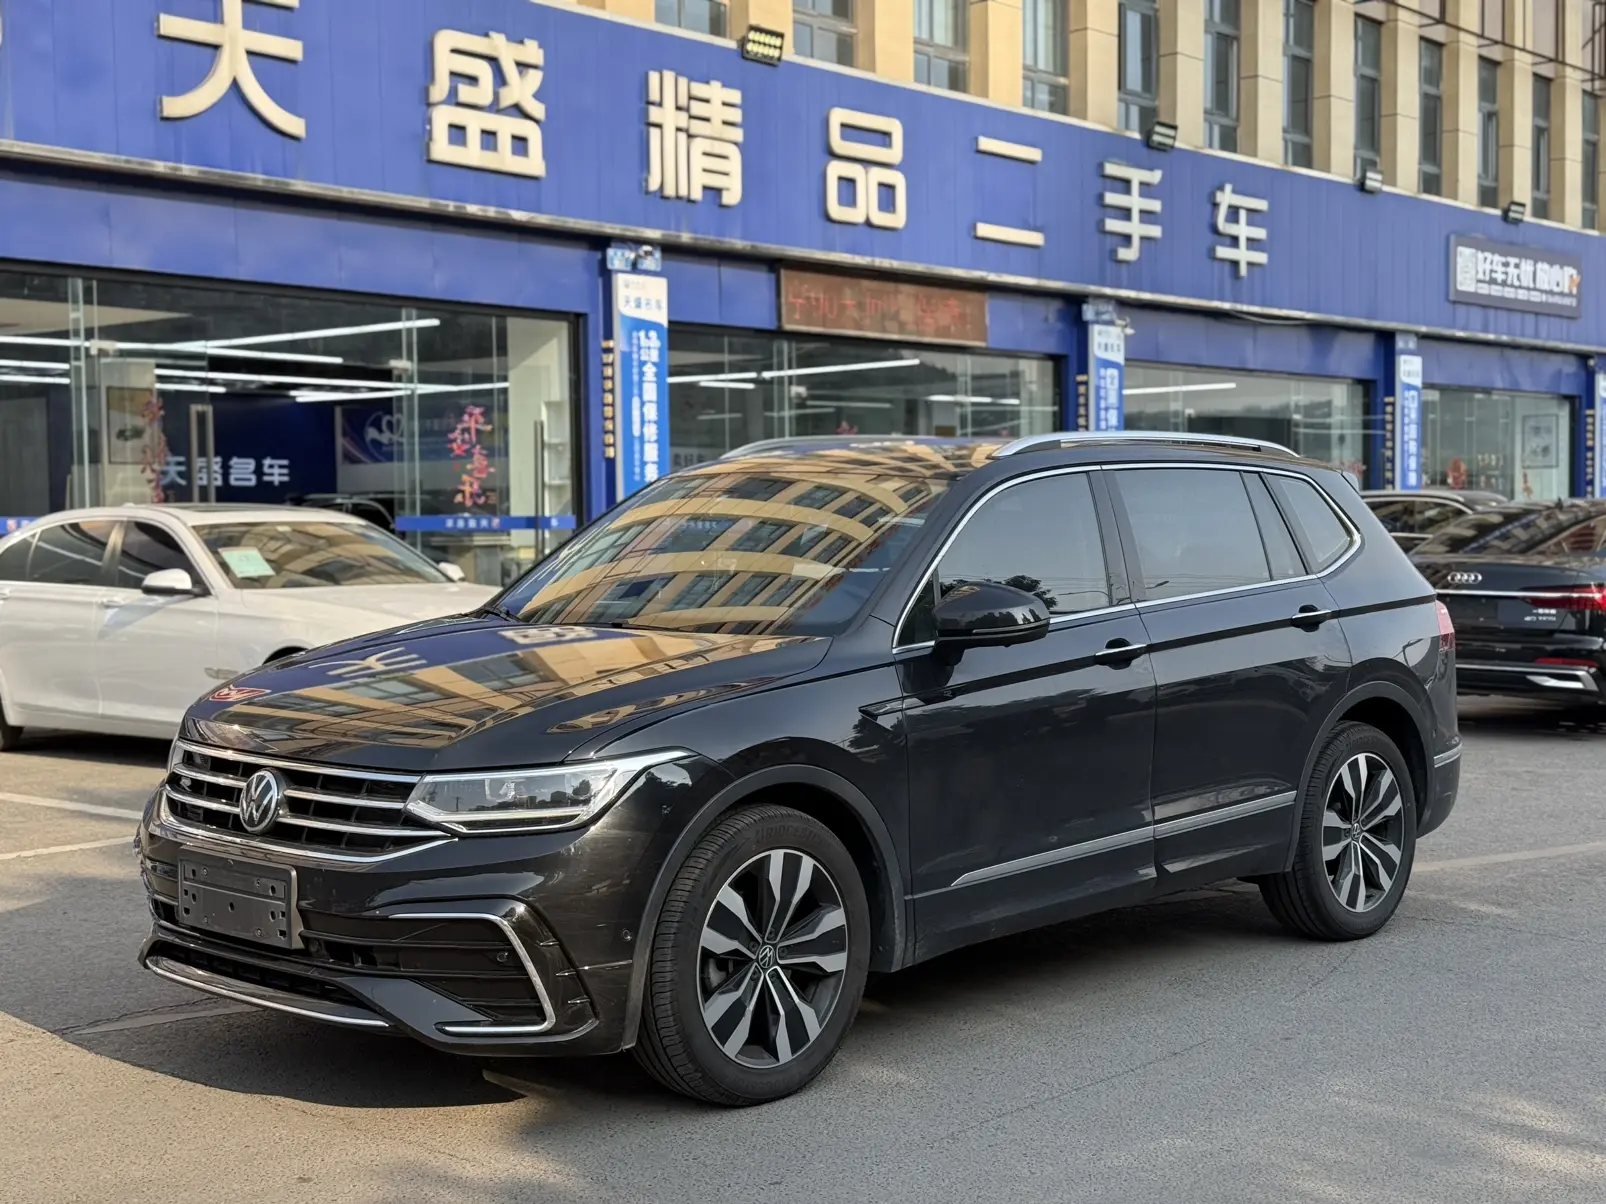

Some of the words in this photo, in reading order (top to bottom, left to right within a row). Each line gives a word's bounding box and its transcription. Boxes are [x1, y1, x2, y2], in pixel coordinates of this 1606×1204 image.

[157, 0, 1269, 278] 天盛精品二手车
